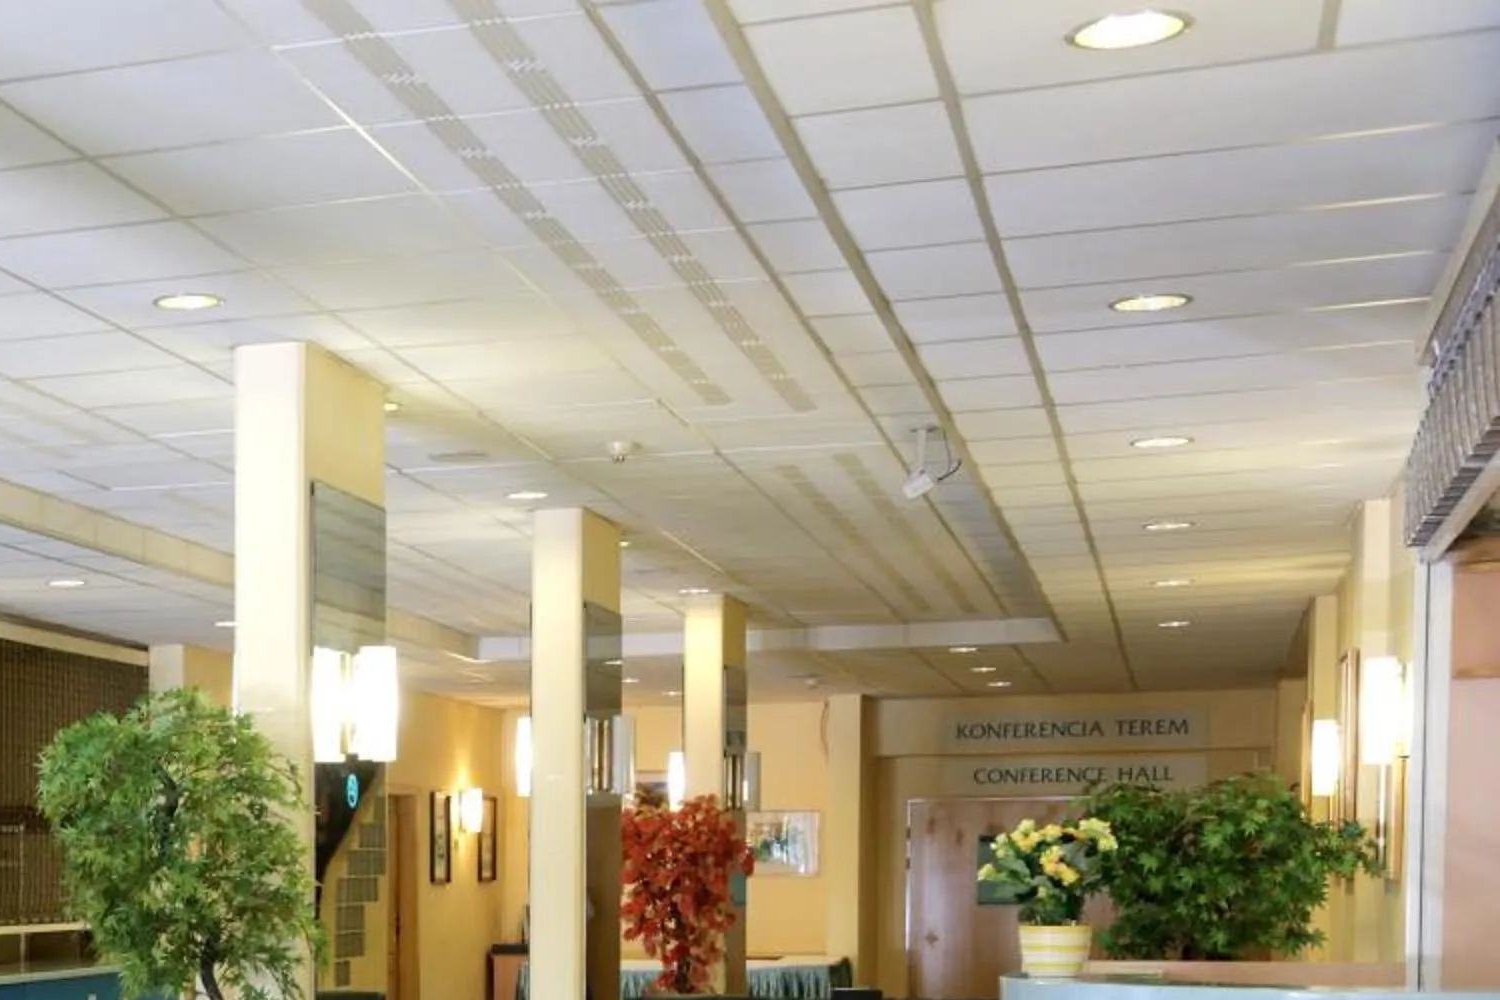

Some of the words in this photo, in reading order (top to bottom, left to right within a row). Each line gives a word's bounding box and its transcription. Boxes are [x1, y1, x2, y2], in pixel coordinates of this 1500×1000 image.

[956, 720, 1104, 740] KONFERENCIA
[1115, 719, 1189, 737] TEREM
[973, 767, 1108, 785] CONFERENCE
[1118, 765, 1173, 782] HALL
